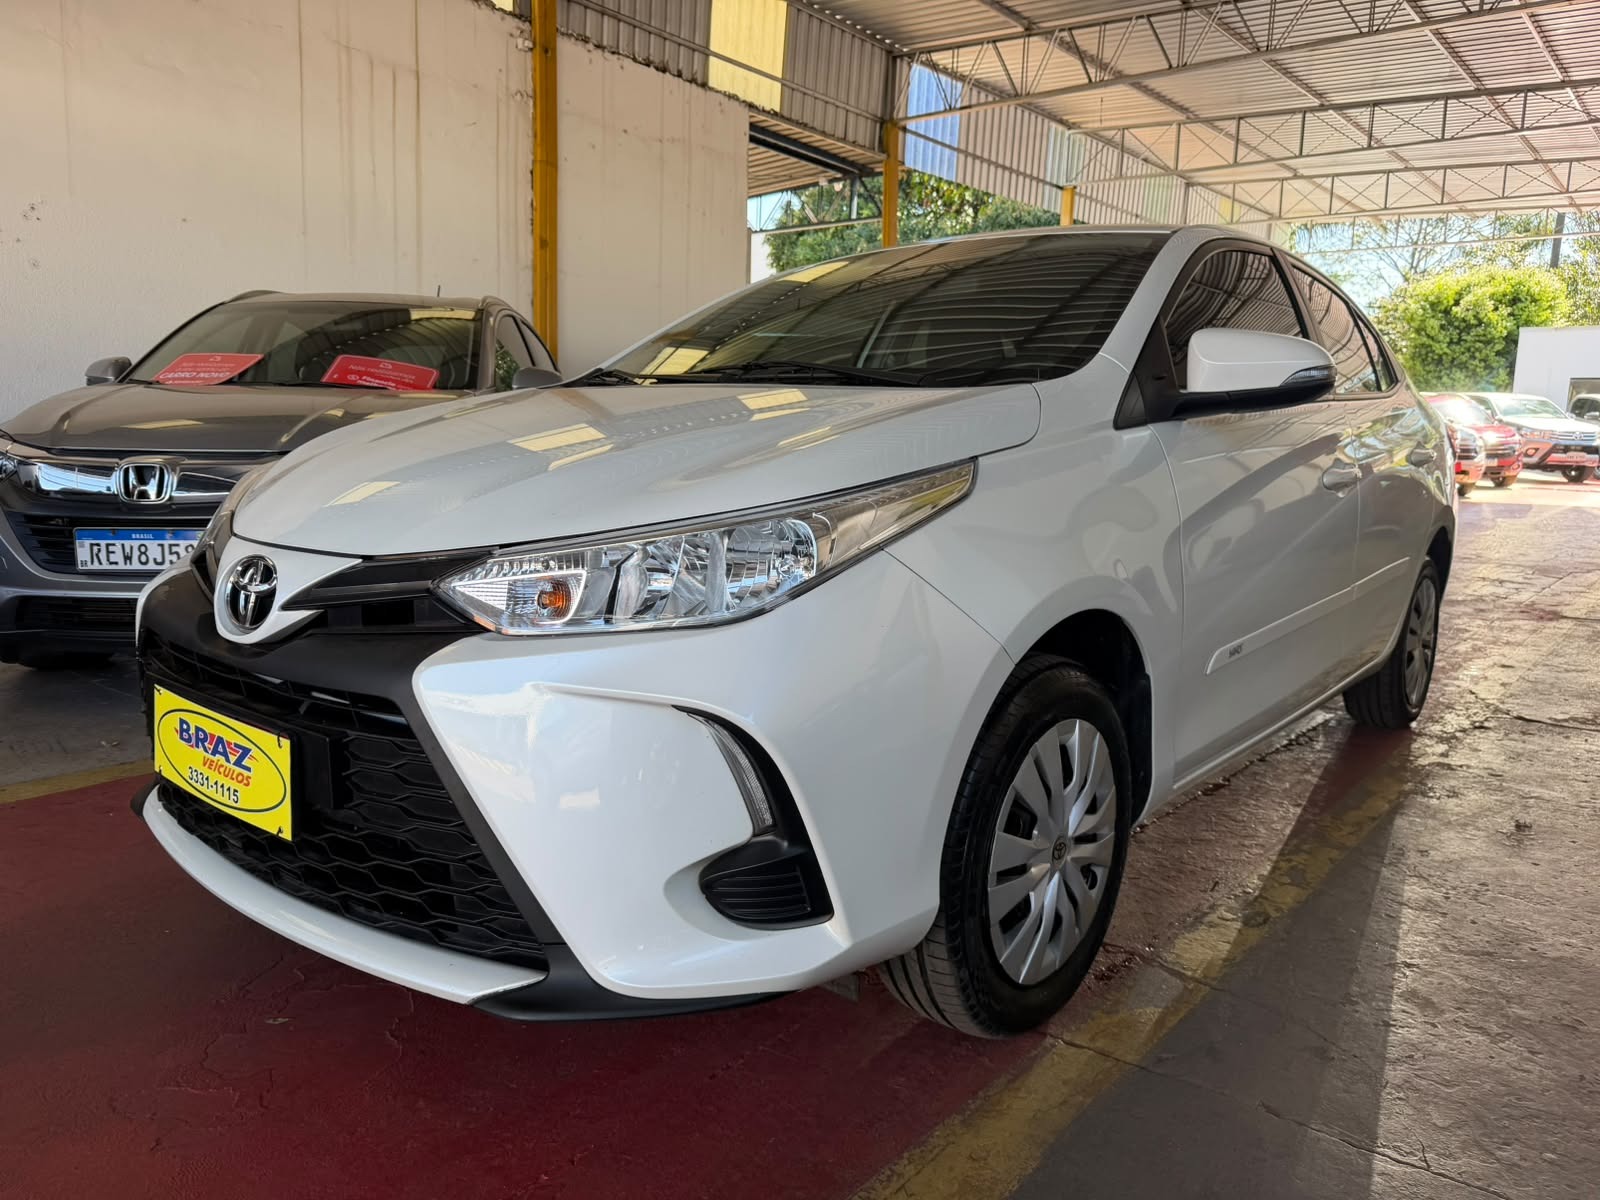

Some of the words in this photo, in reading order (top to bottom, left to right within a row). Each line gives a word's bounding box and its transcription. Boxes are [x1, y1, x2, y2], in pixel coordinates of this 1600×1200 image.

[178, 717, 252, 773] BRAZ
[188, 766, 240, 804] 3331-1115
[202, 756, 252, 787] VEÍCULOS
